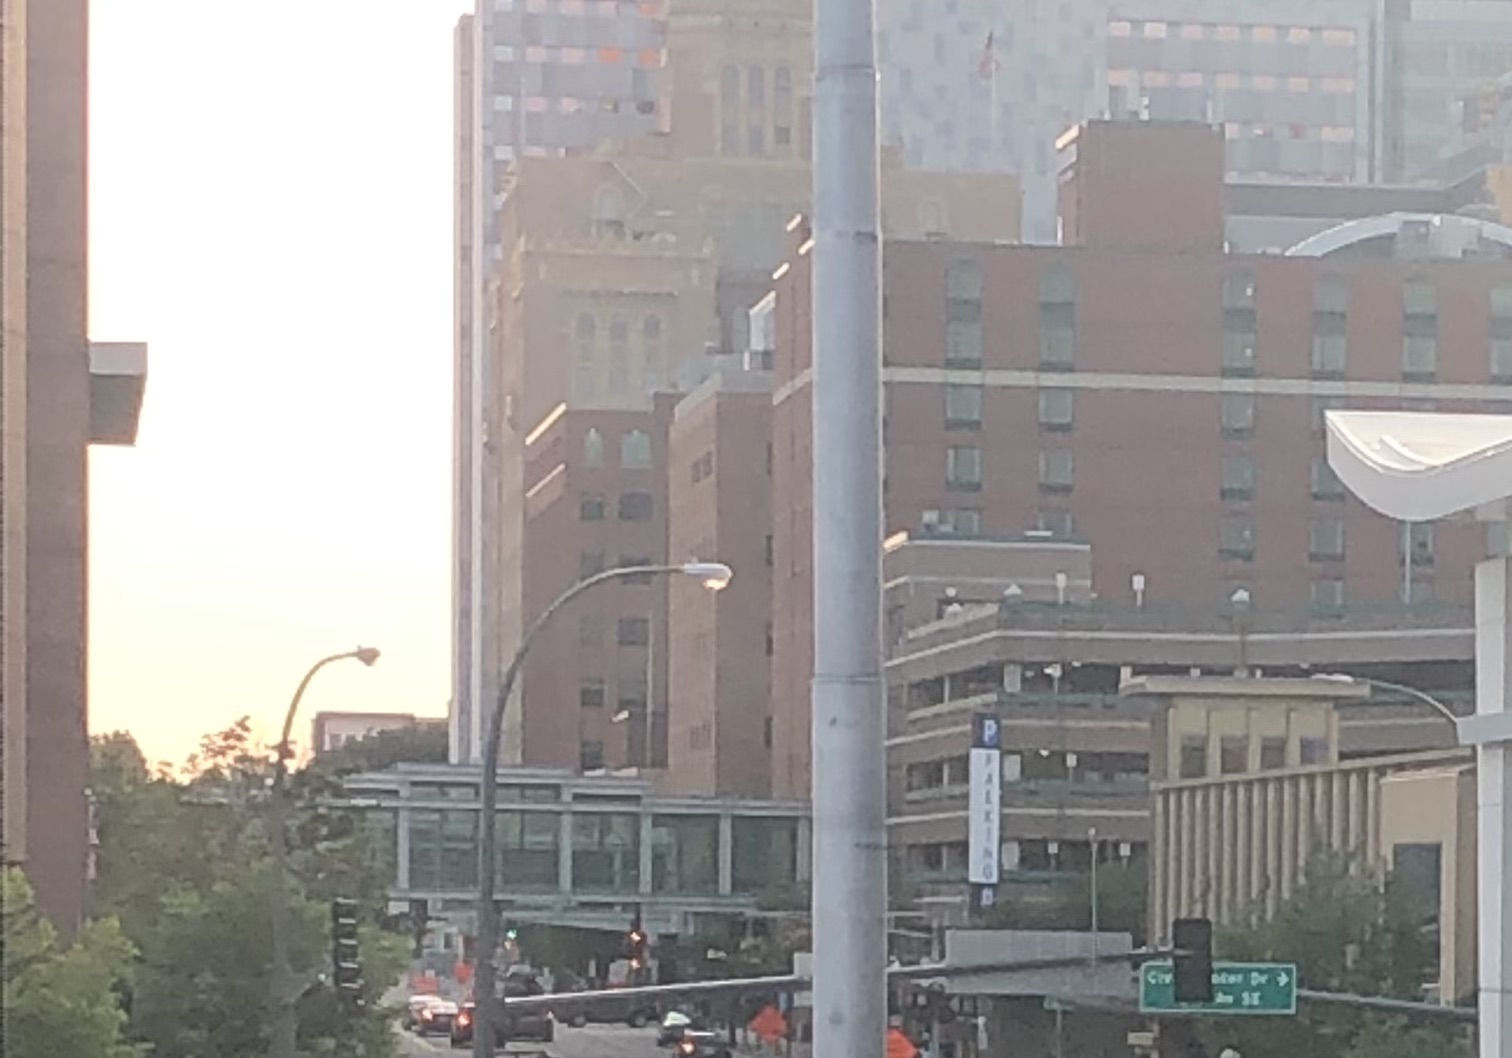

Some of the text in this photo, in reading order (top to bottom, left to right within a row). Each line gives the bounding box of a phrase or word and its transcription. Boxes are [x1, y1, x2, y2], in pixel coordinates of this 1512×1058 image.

[982, 719, 997, 743] P
[982, 753, 994, 880] PARKING
[1250, 971, 1268, 986] Dr
